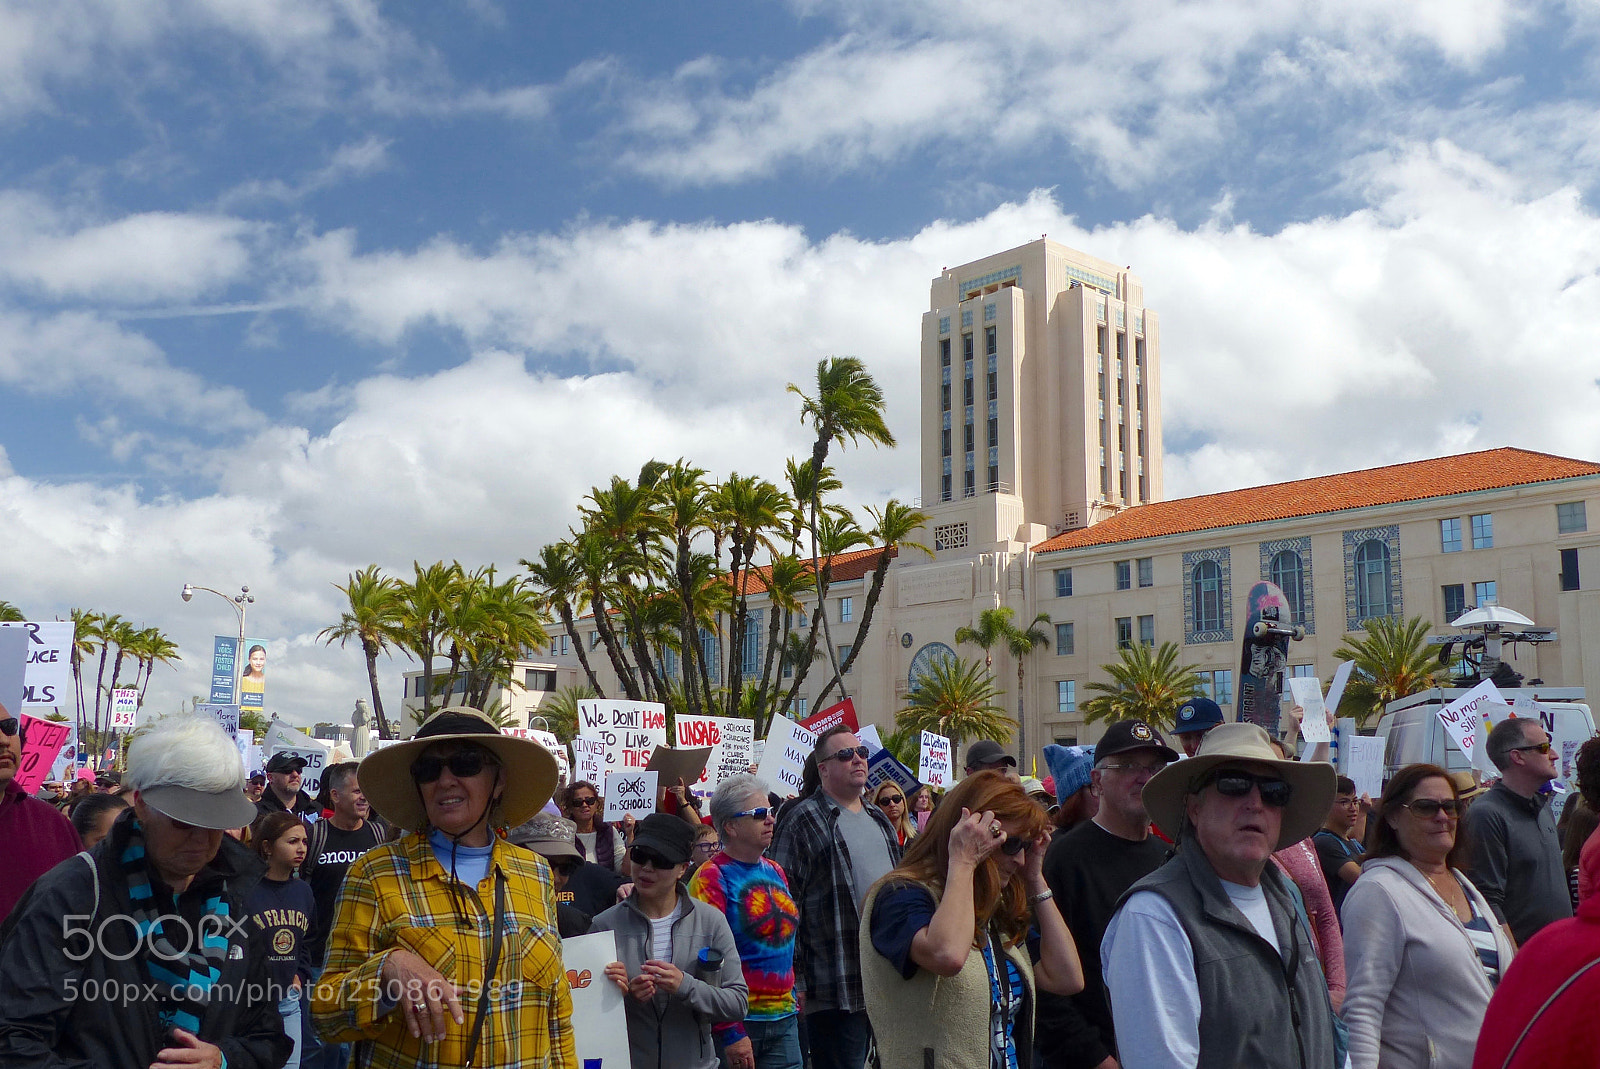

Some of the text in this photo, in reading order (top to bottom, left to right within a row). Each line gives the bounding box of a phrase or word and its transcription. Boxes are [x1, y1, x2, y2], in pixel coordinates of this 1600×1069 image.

[27, 650, 59, 663] LACE
[581, 704, 608, 727] We
[612, 707, 640, 726] DON'T
[809, 714, 834, 731] MOMS
[1439, 709, 1460, 727] No
[726, 723, 751, 733] SCHOOLS
[811, 717, 843, 735] DEMAND
[598, 730, 616, 746] TO
[923, 732, 930, 746] 21
[577, 739, 605, 756] INVEST
[784, 746, 806, 765] MAN
[581, 759, 598, 771] KIDS
[779, 768, 805, 790] MOR
[881, 761, 907, 787] MARCH
[618, 799, 652, 811] SCHOOLS
